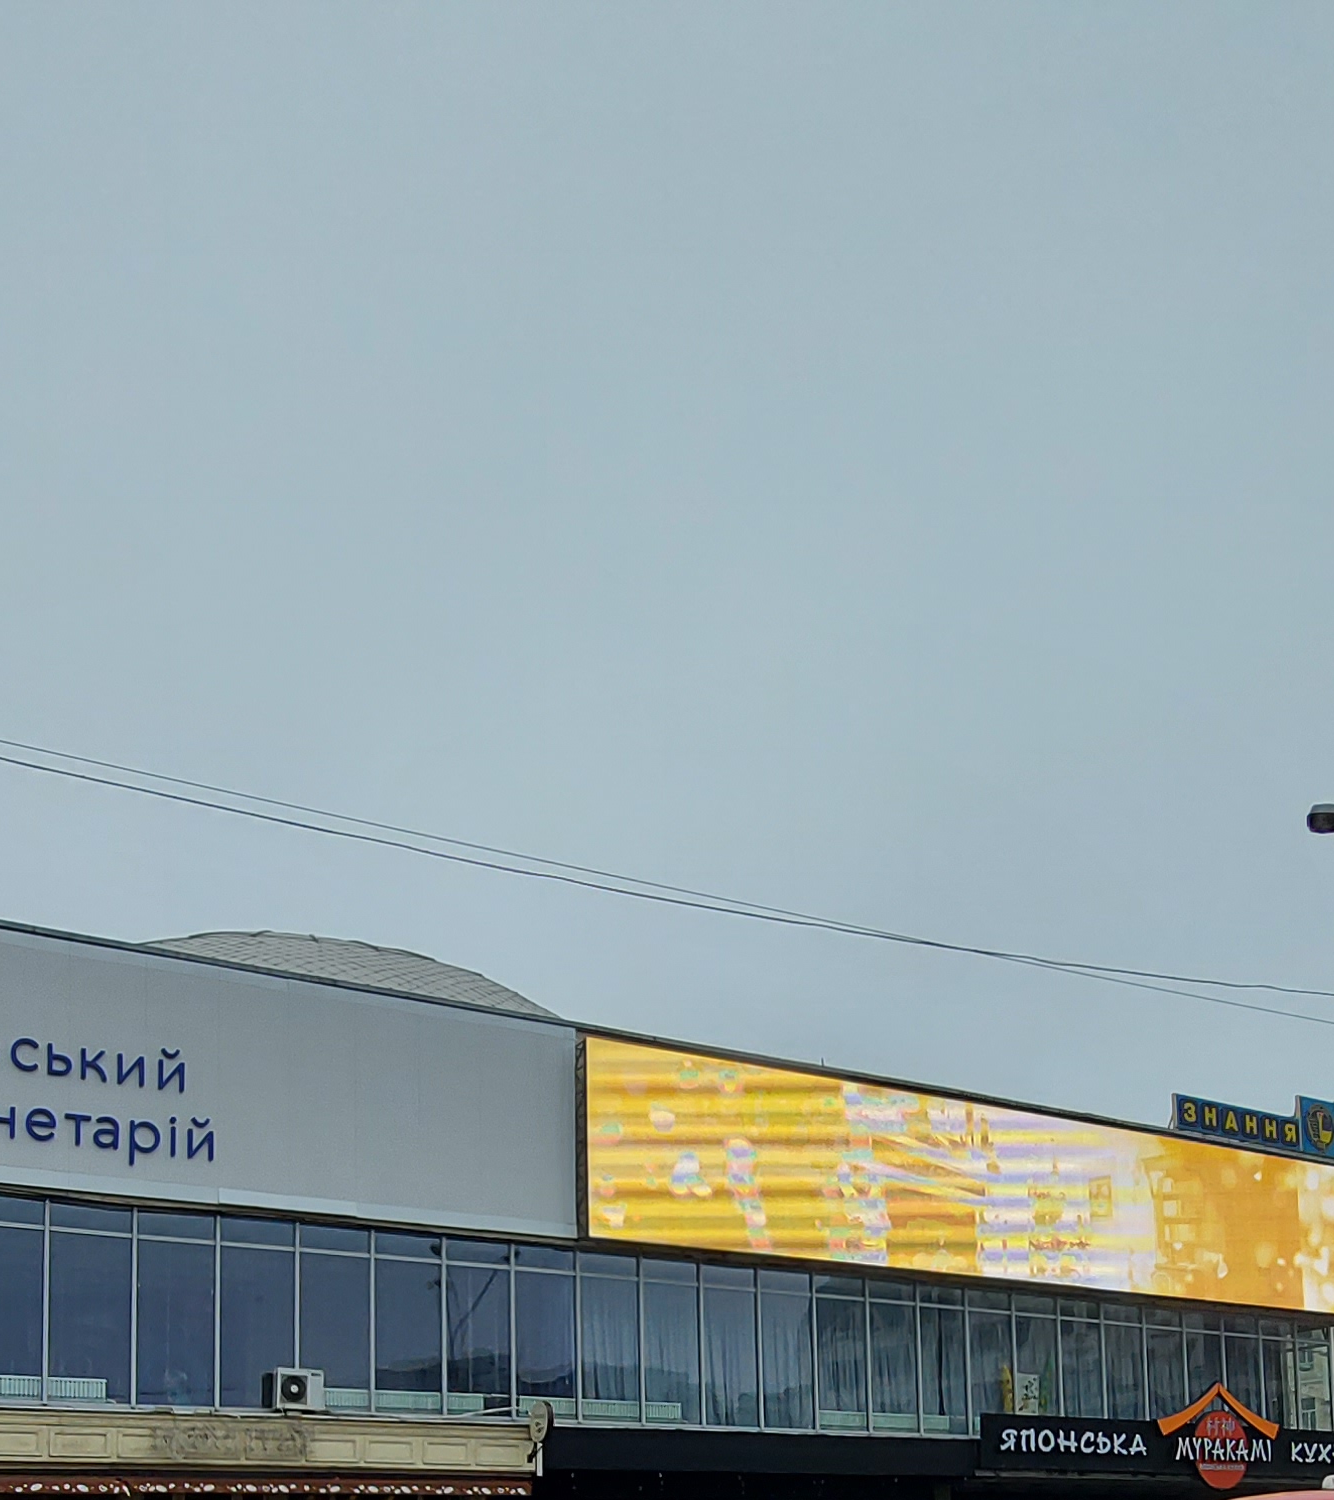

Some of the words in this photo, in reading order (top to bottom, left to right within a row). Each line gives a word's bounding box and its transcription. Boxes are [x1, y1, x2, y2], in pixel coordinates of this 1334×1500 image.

[1183, 1102, 1297, 1143] ЗНАННЯ
[1000, 1428, 1148, 1457] ЯПОНСЬКА
[1175, 1436, 1272, 1462] МУРАКАМІ
